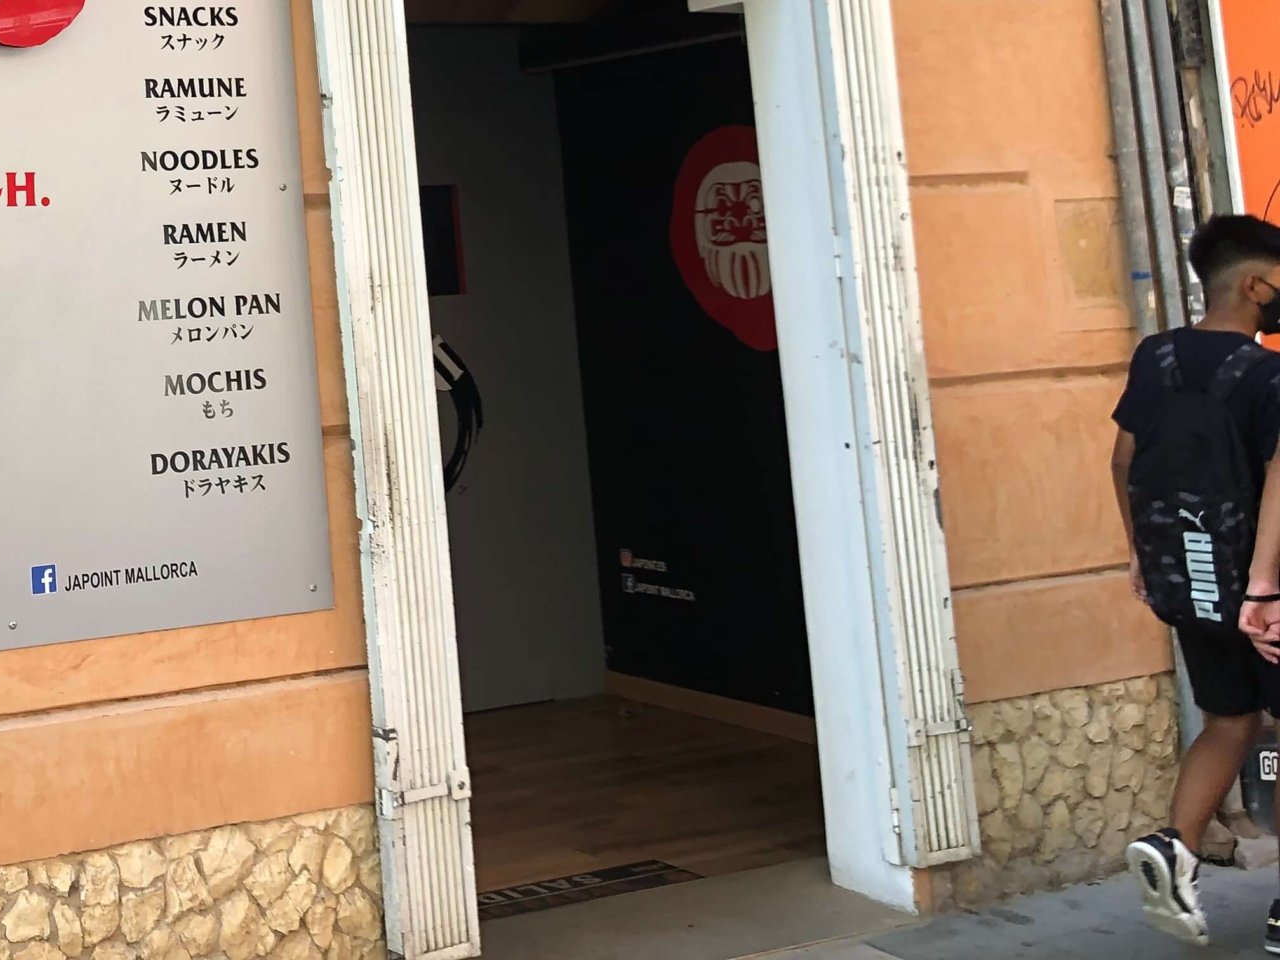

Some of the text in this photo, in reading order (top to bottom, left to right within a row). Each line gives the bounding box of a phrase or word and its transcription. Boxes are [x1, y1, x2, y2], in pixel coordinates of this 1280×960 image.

[144, 7, 238, 26] SNACKS
[161, 34, 224, 50] スナック
[145, 78, 246, 98] RAMUNE
[156, 106, 238, 122] ラミューン
[141, 149, 258, 171] NOODLES
[170, 177, 234, 194] ヌードル
[163, 222, 246, 244] RAMEN
[174, 250, 239, 269] ラーメン
[138, 293, 280, 321] MELON PAN
[172, 324, 253, 344] メロンパン
[165, 369, 266, 396] MOCHIS
[203, 400, 233, 419] もち
[151, 442, 290, 475] DORAYAKIS
[184, 475, 265, 498] ドラヤキス
[65, 561, 198, 591] JAPOINT MALLORCA
[1184, 531, 1223, 623] PUMA
